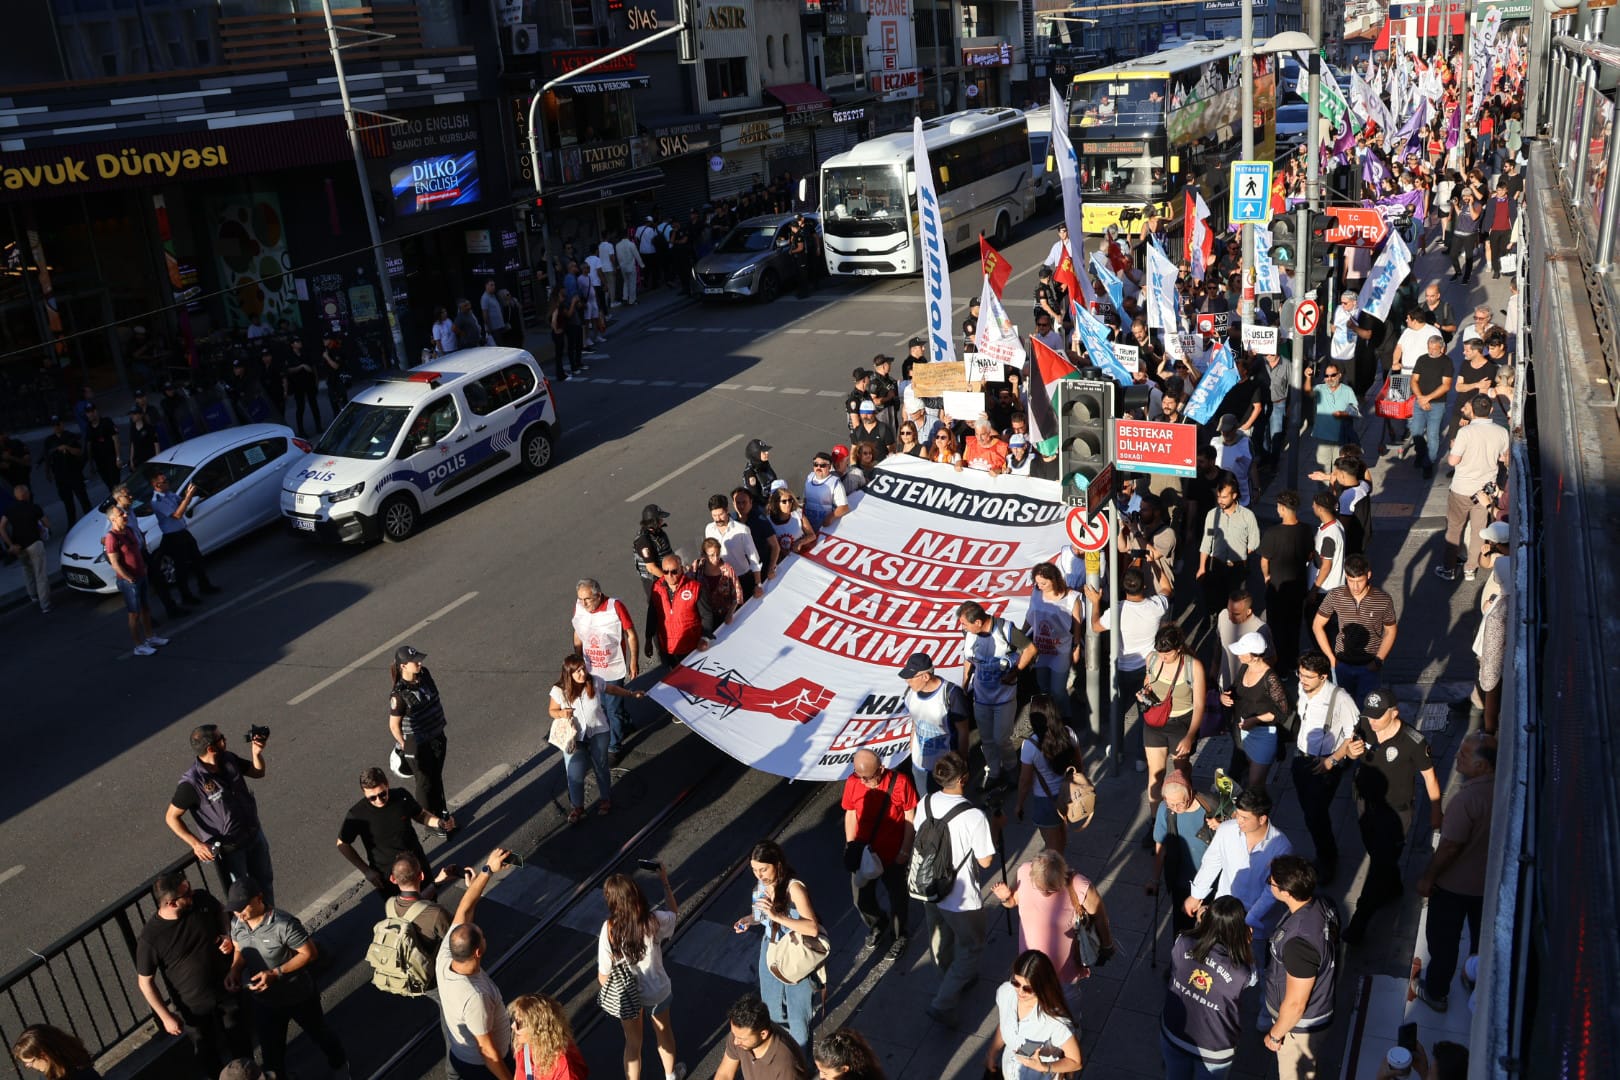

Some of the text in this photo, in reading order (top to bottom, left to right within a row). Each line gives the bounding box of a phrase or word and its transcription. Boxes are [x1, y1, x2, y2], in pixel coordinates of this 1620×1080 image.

[426, 113, 470, 131] ENGLISH
[582, 143, 629, 163] TATTOO
[0, 145, 229, 190] avuk Dünyası
[412, 159, 457, 181] DİLKO
[414, 175, 460, 195] ENGLISH
[1215, 314, 1227, 323] NO
[1119, 425, 1174, 441] BESTEKAR
[1119, 439, 1173, 454] DİLHAYAT
[297, 468, 336, 483] POLİS
[427, 454, 466, 484] POLİS
[910, 530, 1010, 565] NATO
